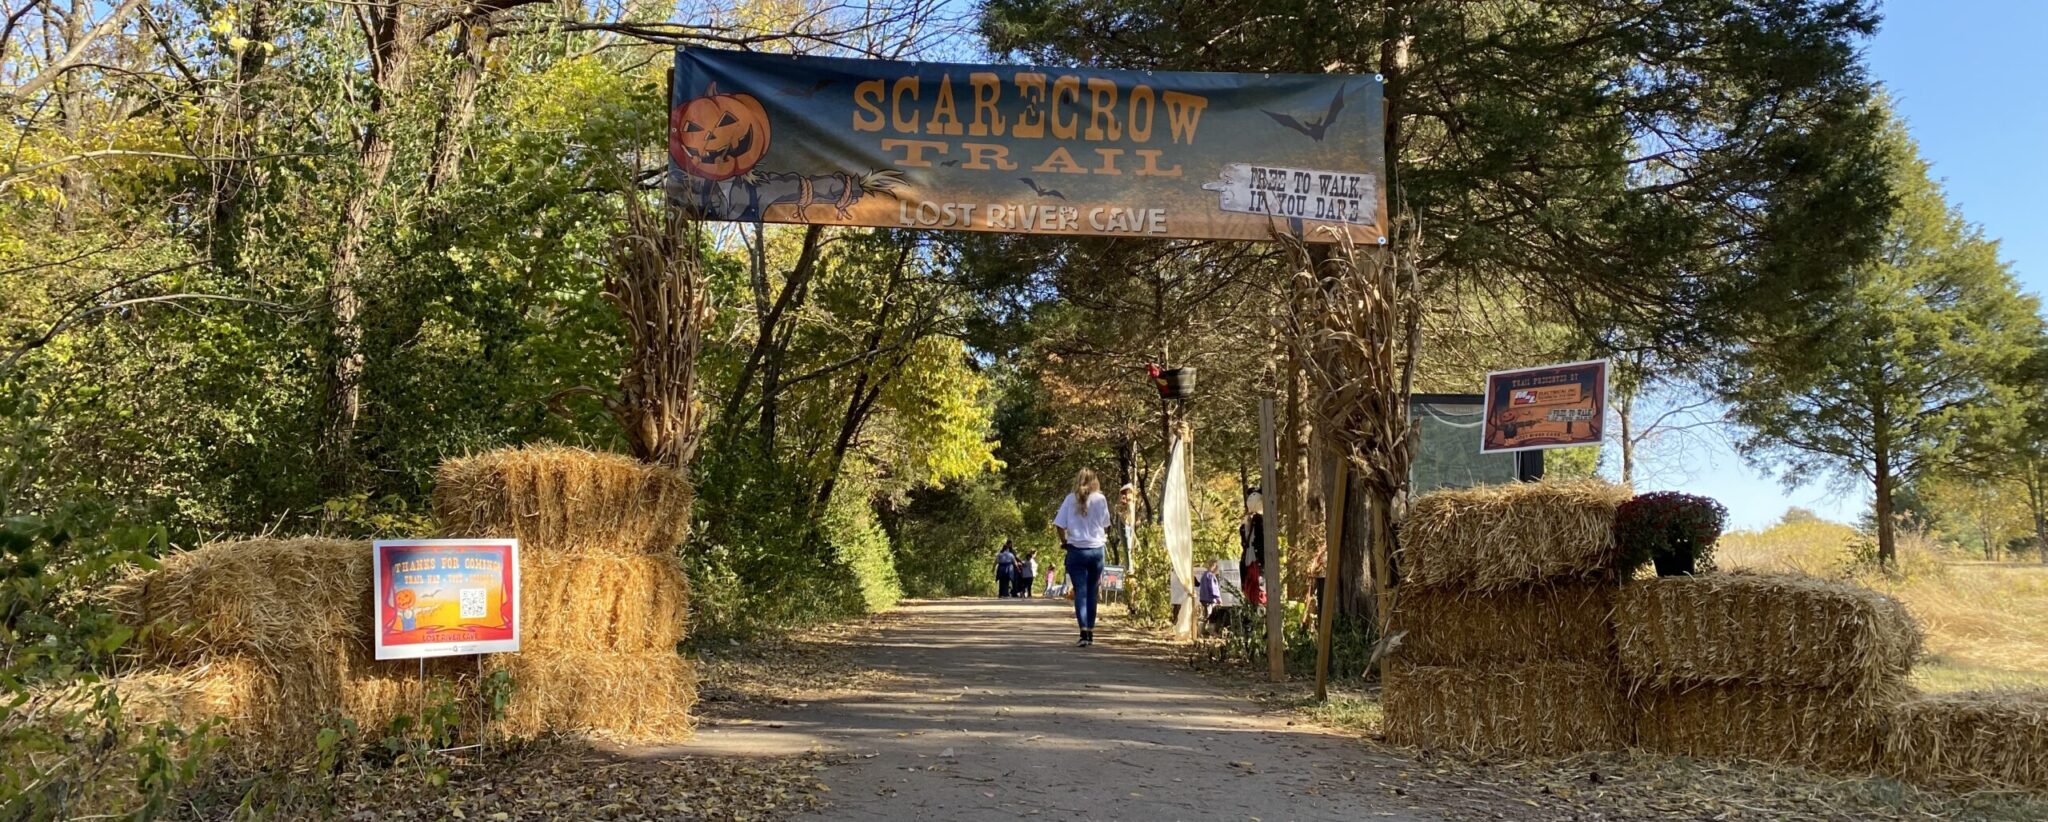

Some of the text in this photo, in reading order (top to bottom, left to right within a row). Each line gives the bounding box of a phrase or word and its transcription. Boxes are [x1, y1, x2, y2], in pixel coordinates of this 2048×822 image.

[853, 72, 1208, 145] SCARECROW
[881, 138, 1183, 178] TRAIL
[1249, 168, 1363, 200] FREE TO WALK,
[900, 200, 1168, 235] LOST RIVER CAVE
[1249, 191, 1360, 222] IF YOU DARE
[395, 558, 436, 573] THANKS
[441, 557, 459, 570] FOR
[462, 633, 479, 641] CAVE
